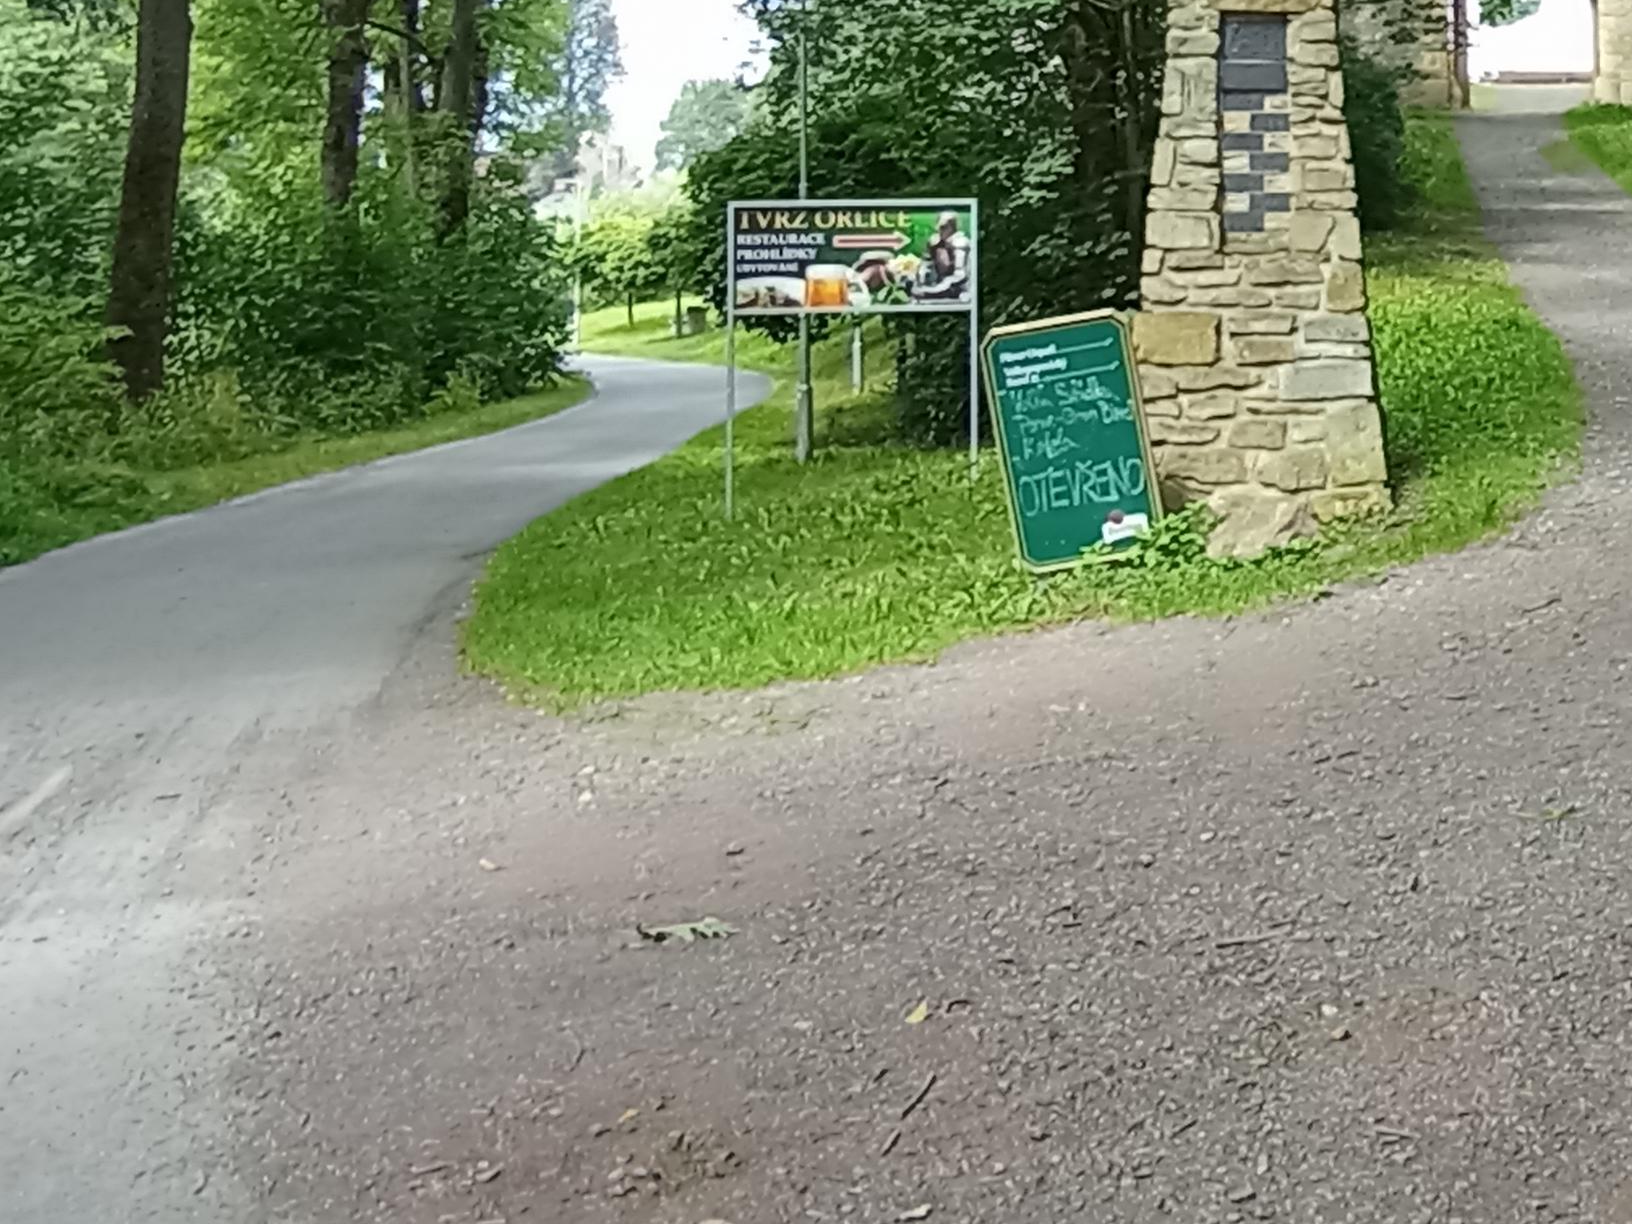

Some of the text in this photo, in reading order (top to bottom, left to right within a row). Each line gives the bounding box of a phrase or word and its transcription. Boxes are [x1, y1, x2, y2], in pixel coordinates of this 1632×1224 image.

[738, 209, 913, 230] TVRZ ORLICE
[736, 233, 826, 246] RESTAURACE
